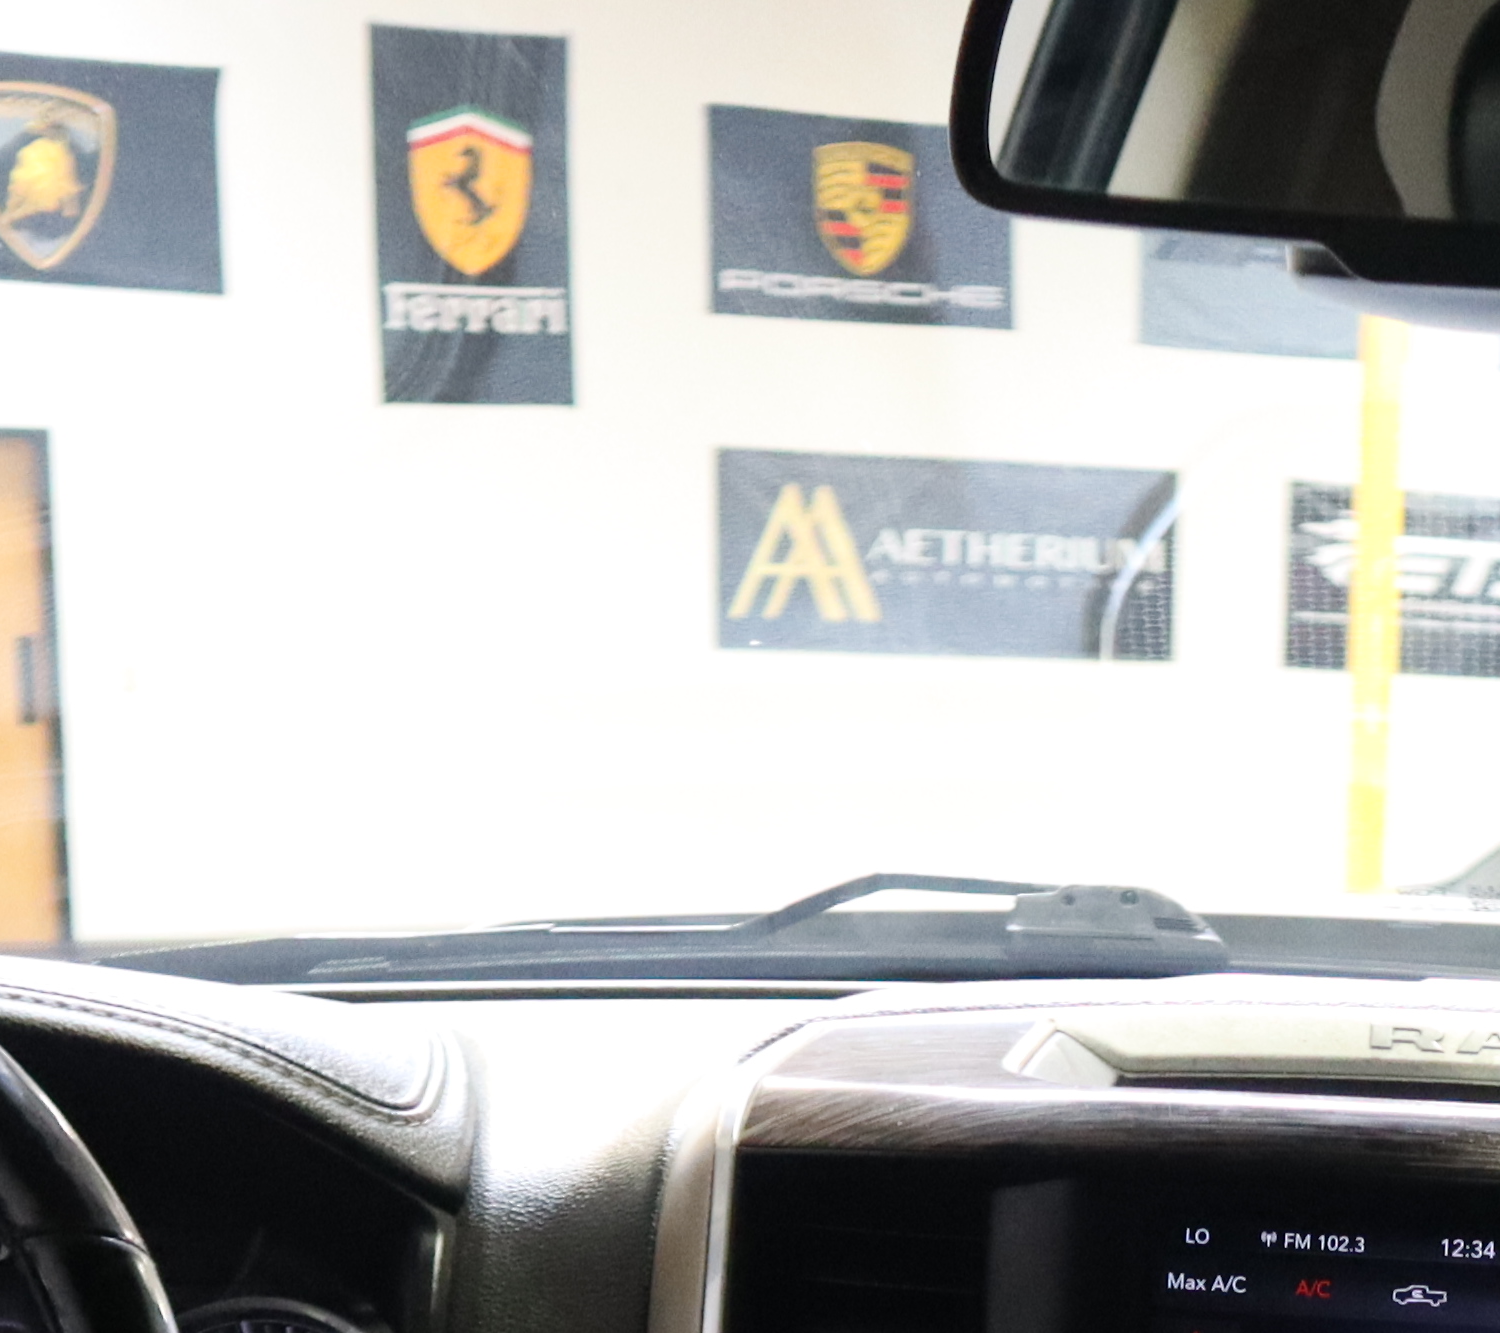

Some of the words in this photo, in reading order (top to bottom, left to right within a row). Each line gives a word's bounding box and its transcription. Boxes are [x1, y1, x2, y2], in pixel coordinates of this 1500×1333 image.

[718, 268, 1005, 309] PORSCHE
[384, 281, 568, 335] Ferrari
[866, 527, 1167, 573] AETHERIUM
[1184, 1227, 1210, 1245] LO
[1283, 1232, 1311, 1250] FM
[1318, 1234, 1365, 1253] 102.3
[1441, 1238, 1496, 1260] 12:34
[1166, 1271, 1207, 1292] Max
[1211, 1274, 1247, 1295] A/C
[1295, 1279, 1332, 1298] A/C
